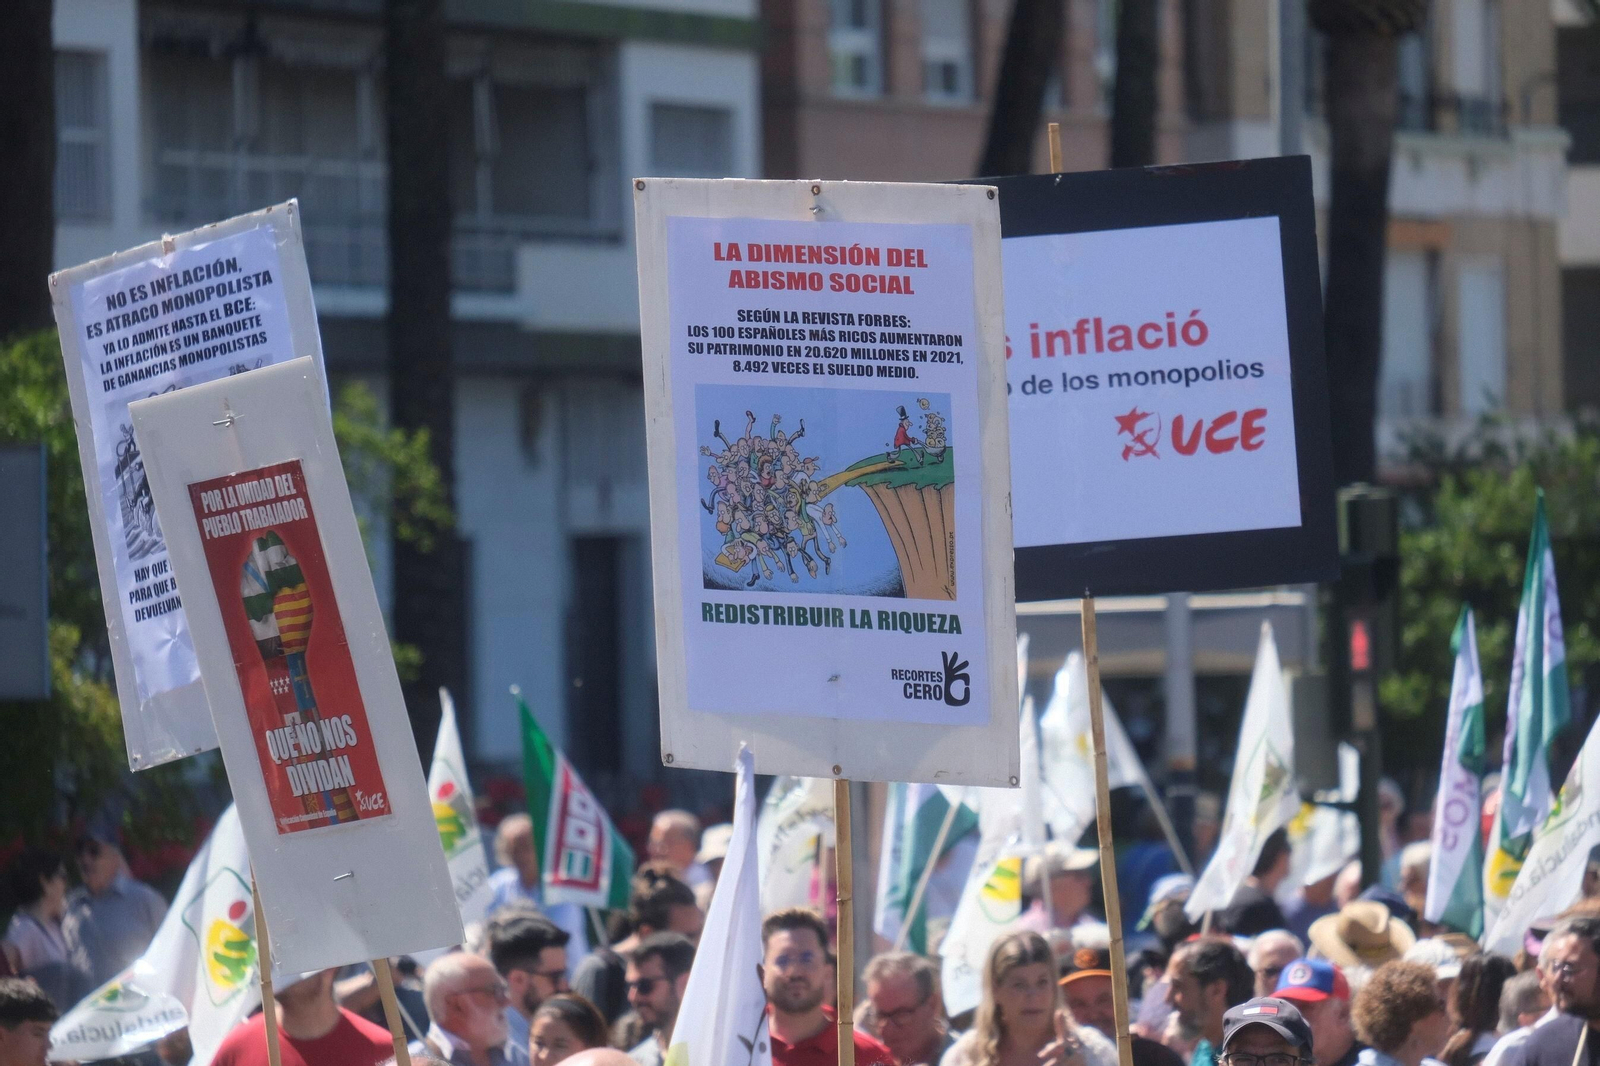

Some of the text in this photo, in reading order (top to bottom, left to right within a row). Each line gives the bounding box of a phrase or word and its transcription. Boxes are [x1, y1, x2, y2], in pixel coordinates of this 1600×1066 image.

[714, 242, 928, 268] LA DIMENSIÓN DEL
[106, 257, 242, 311] NO ES INFLACIÓN,
[729, 270, 914, 294] ABISMO SOCIAL
[86, 270, 272, 340] ES ATRACO MONOPOLISTA
[738, 308, 910, 328] SEGÚN LA REVISTA FORBES:
[103, 297, 255, 356] YA LO ADMITE HASTA EL BCE:
[688, 326, 962, 346] LOS 100 ESPAÑOLES MÁS RICOS AUMENTARON
[1030, 310, 1208, 358] inflació
[100, 314, 262, 375] LA INFLACIÓN ES UN BANQUETE
[688, 342, 963, 364] SU PATRIMONIO EN 20.620 MILLONES EN 2021,
[103, 332, 267, 392] DE GANANCIAS MONOPOLISTAS
[733, 360, 918, 378] 8.492 VECES EL SUELDO MEDIO.
[1021, 374, 1053, 395] de
[1062, 372, 1100, 392] los
[1108, 360, 1264, 388] monopolios
[1171, 408, 1267, 456] UCE
[201, 473, 296, 513] POR LA UNIDAD DEL
[202, 498, 308, 539] PUEBLO TRABAJADOR
[134, 566, 149, 582] HAY
[152, 560, 168, 577] QUE
[129, 584, 154, 604] PARA
[153, 580, 169, 597] QUE
[135, 596, 182, 622] DEVUELVAN
[702, 602, 962, 634] REDISTRIBUIR LA RIQUEZA
[891, 668, 943, 684] RECORTES
[903, 683, 943, 701] CERO
[266, 714, 357, 764] QUE NO NOS
[286, 755, 355, 797] DIVIDAN
